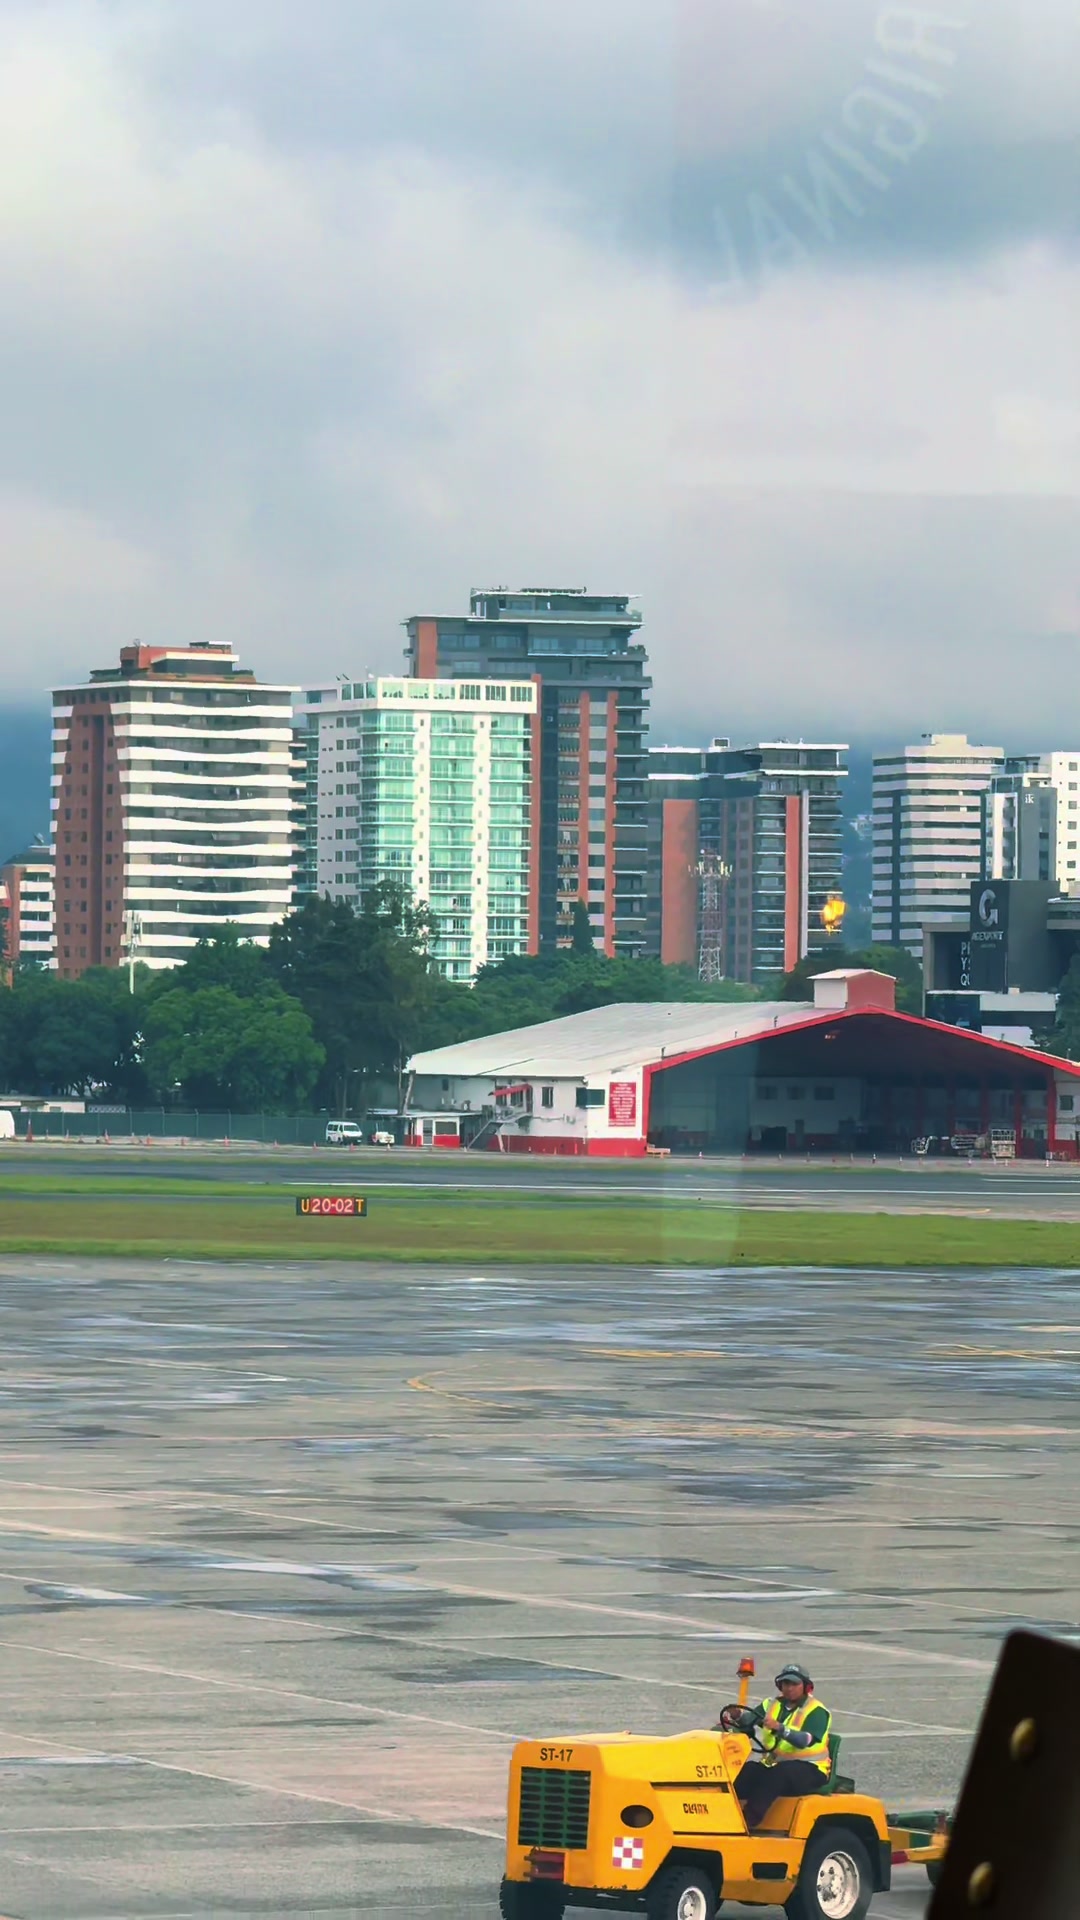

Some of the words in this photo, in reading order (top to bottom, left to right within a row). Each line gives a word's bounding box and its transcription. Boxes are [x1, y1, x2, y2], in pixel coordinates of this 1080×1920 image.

[311, 1198, 353, 1213] 20-02
[539, 1747, 573, 1762] ST-17
[695, 1765, 723, 1778] ST-17
